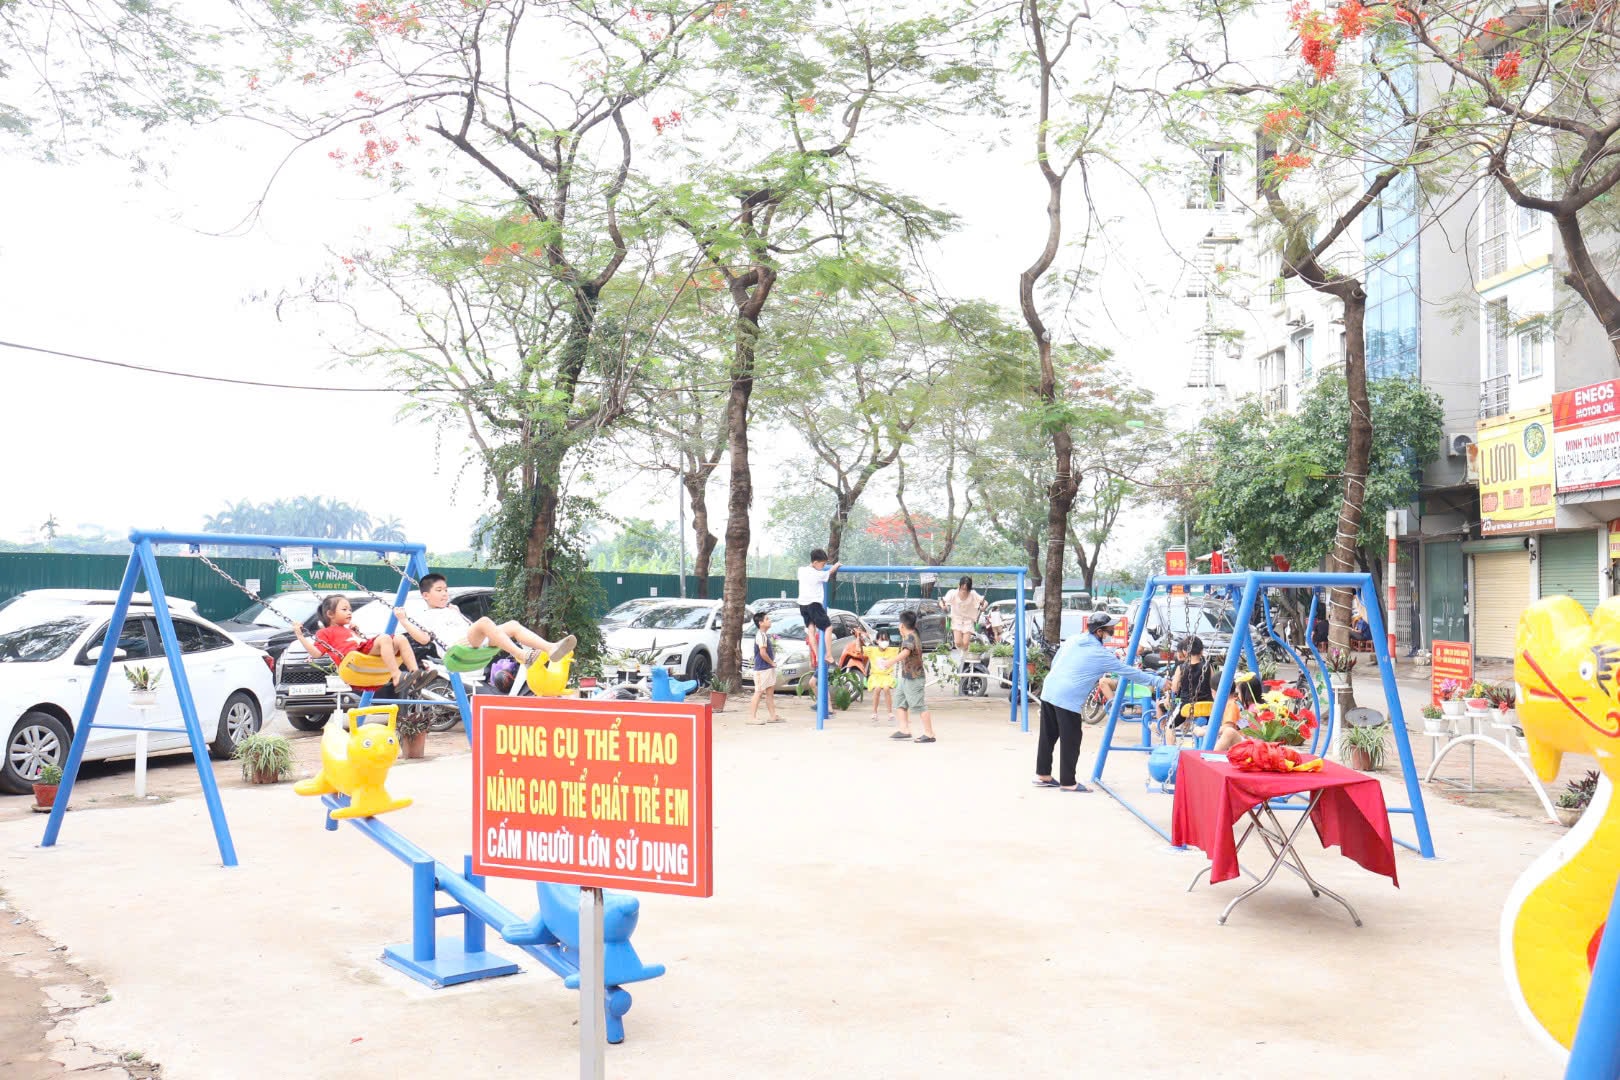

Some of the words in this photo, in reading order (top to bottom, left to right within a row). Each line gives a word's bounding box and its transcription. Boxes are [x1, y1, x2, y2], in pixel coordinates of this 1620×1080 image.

[1574, 383, 1614, 406] ENEOS
[1575, 405, 1601, 419] MOTOR
[1602, 402, 1615, 413] OIL
[1565, 438, 1583, 451] MINH
[1603, 431, 1620, 444] MOT
[309, 571, 325, 580] VAY
[496, 724, 547, 762] DỤNG
[553, 727, 579, 766] CỤ
[584, 717, 622, 761] THỂ
[626, 731, 678, 765] THAO
[487, 769, 525, 814] NÂNG
[529, 778, 557, 816] CAO
[561, 767, 588, 819] THỂ
[591, 771, 628, 822] CHẤT
[633, 774, 660, 824] TRẺ
[665, 788, 689, 826] EM
[487, 817, 522, 860] CẤM
[526, 826, 574, 865] NGƯỜI
[578, 830, 610, 868] LỚN
[615, 829, 639, 871] SỬ
[642, 841, 689, 880] DỤNG
